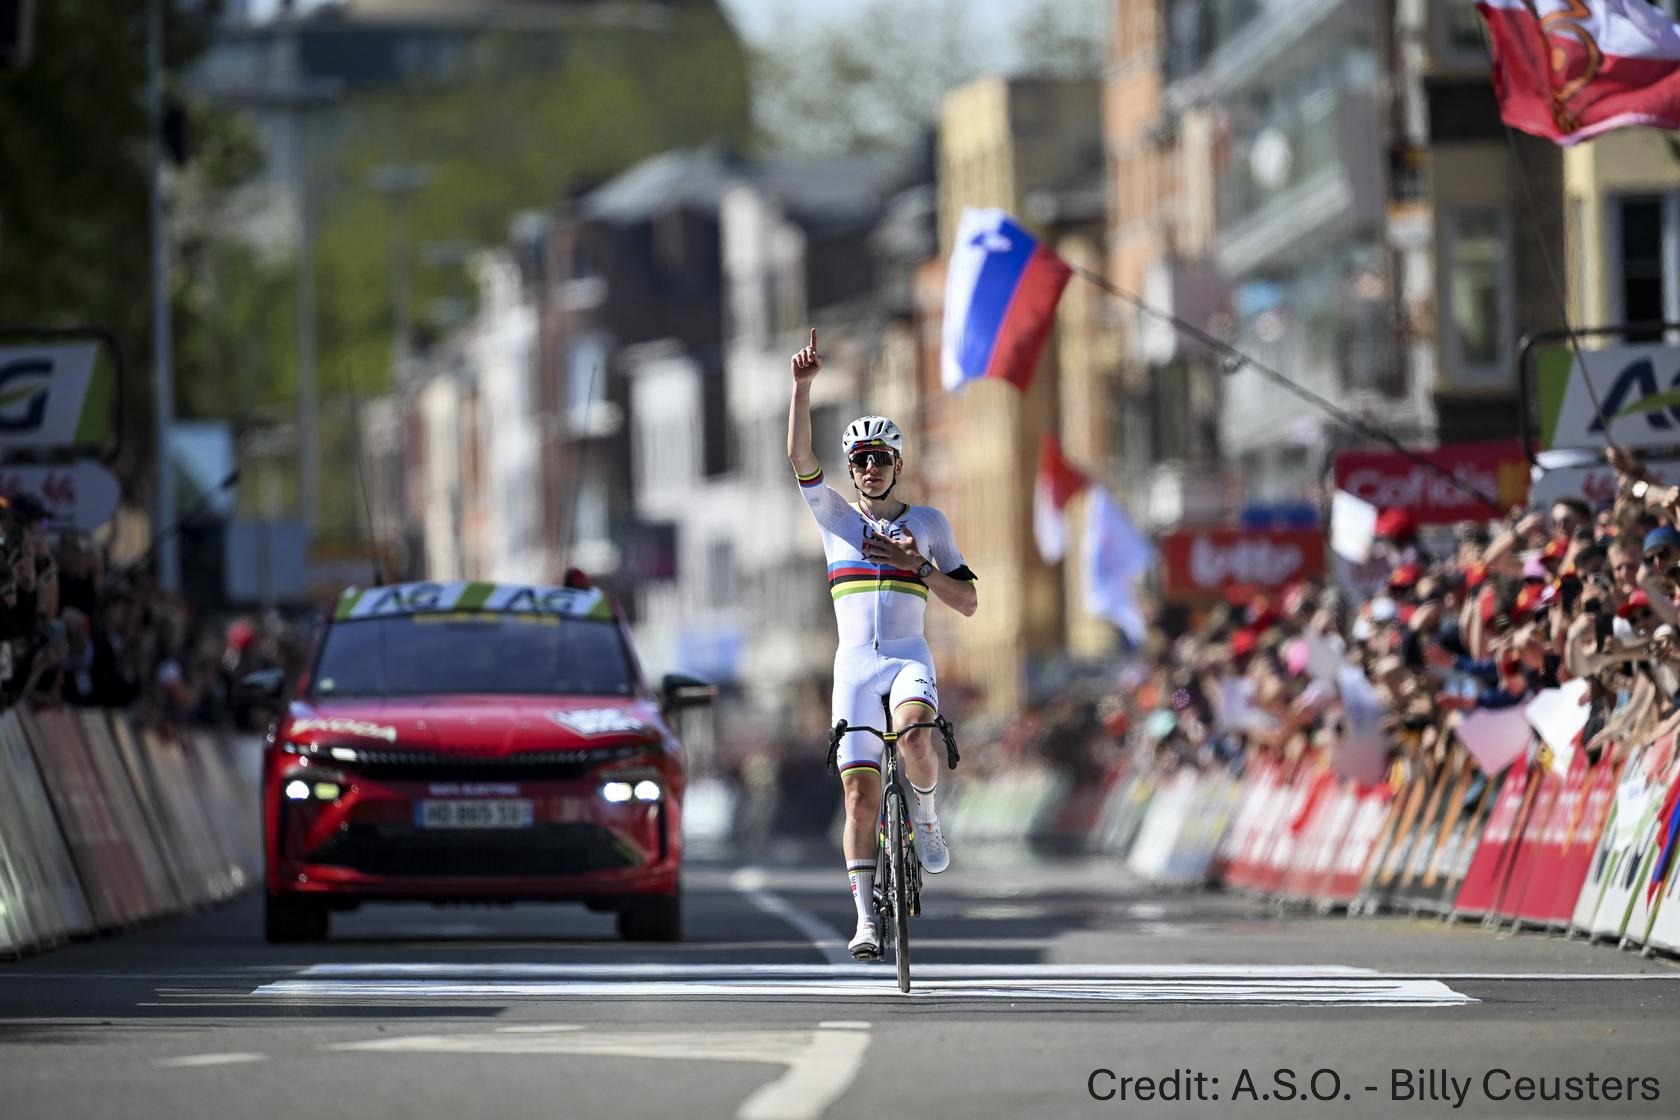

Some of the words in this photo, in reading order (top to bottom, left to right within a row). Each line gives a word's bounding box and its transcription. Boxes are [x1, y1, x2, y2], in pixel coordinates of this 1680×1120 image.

[1587, 358, 1680, 433] A
[371, 583, 443, 614] AG
[504, 588, 577, 614] AG
